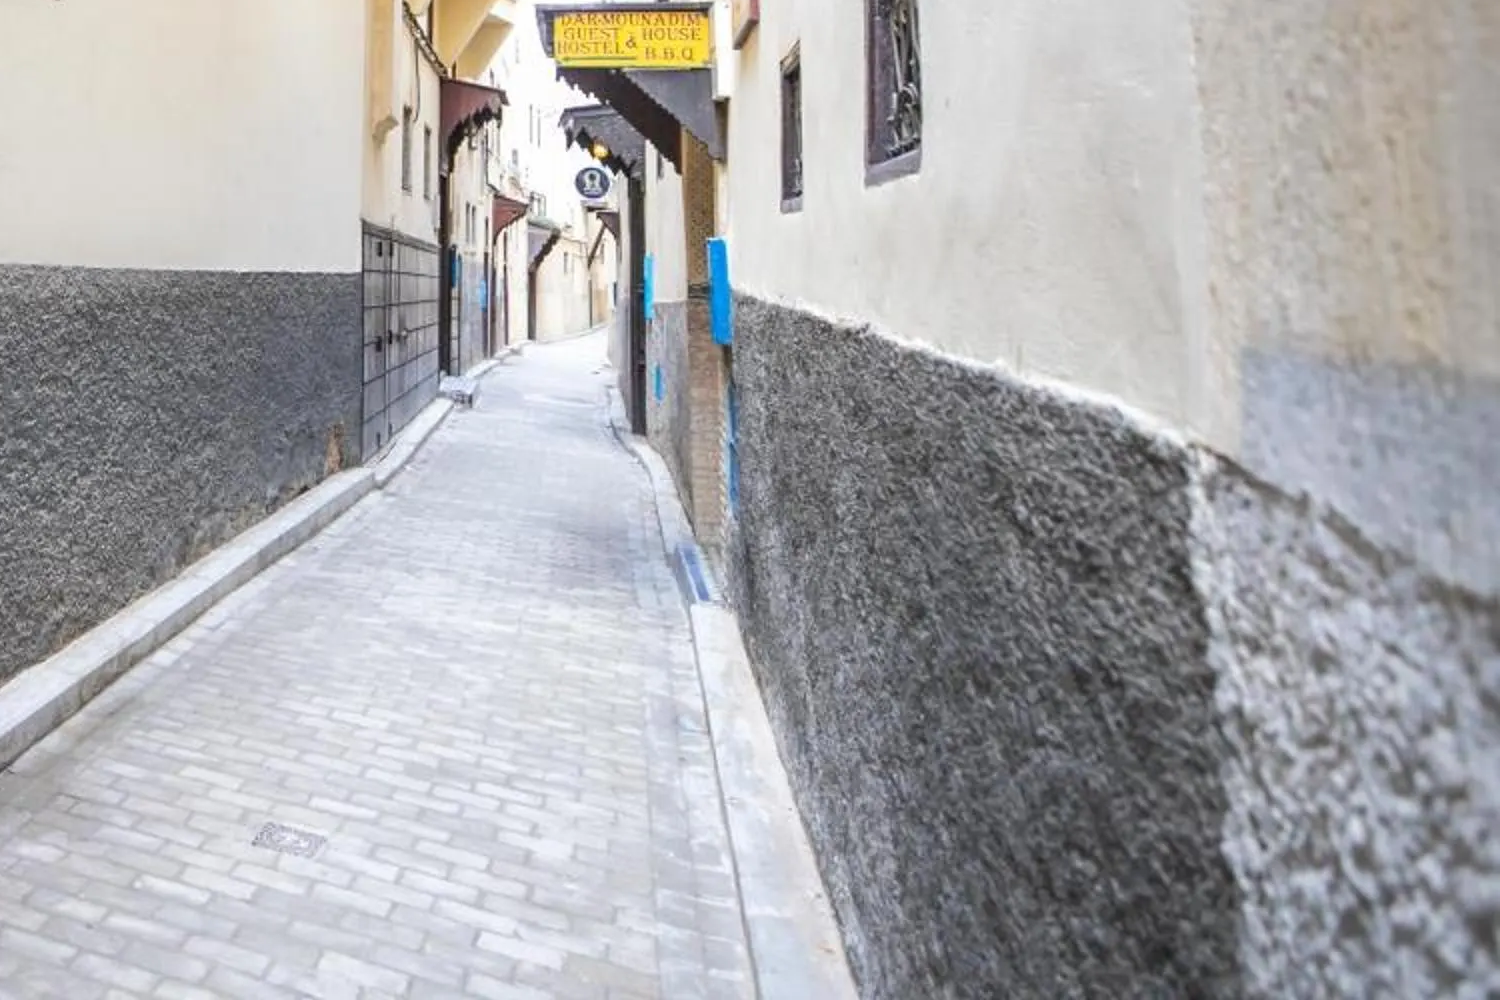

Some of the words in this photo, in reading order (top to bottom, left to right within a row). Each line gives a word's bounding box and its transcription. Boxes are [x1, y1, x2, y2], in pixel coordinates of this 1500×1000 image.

[563, 27, 619, 41] GUEST
[642, 27, 701, 41] HOUSE
[557, 41, 625, 55] HOSTEL
